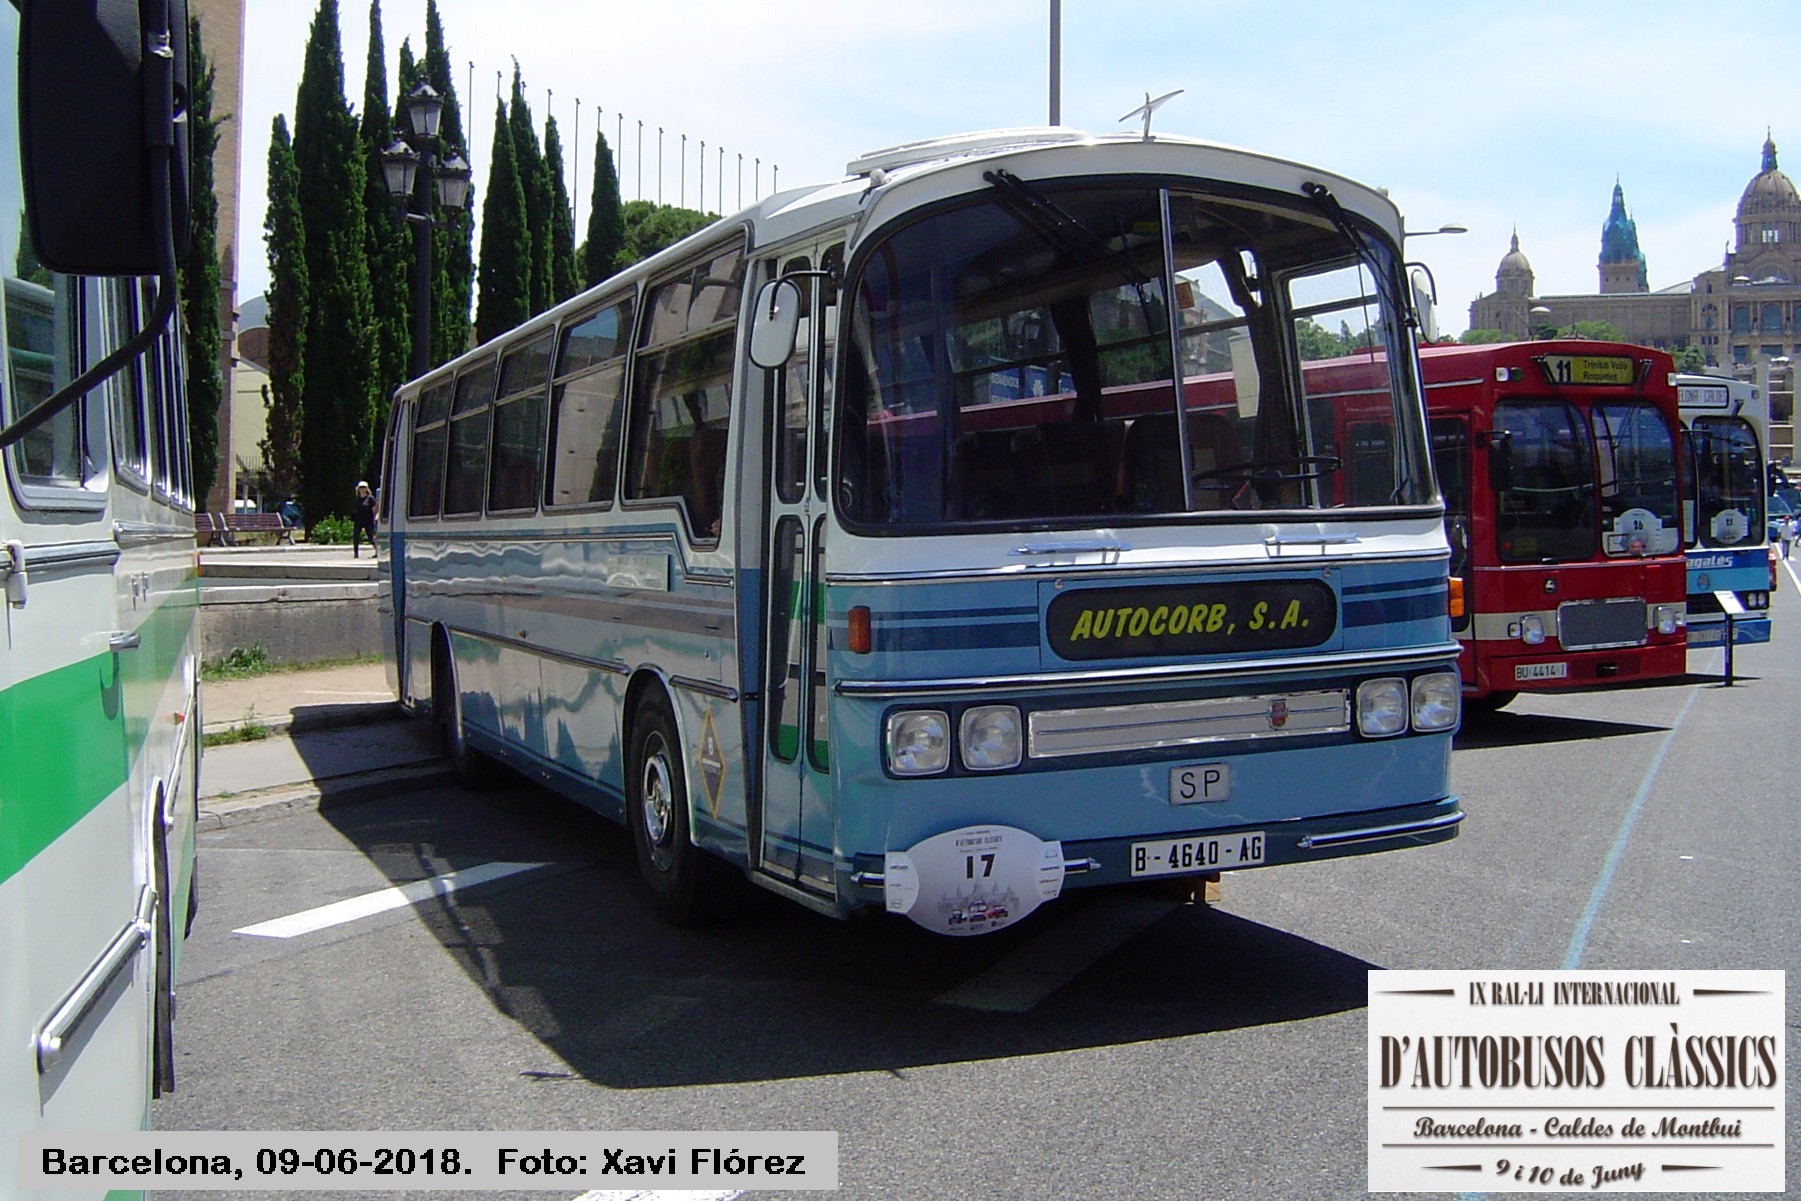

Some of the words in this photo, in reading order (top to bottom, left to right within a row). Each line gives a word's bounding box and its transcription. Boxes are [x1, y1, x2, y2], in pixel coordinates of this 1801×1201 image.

[1556, 360, 1571, 382] 11
[1070, 604, 1235, 641] AUTOCORB,
[1249, 600, 1309, 631] S.A.
[1180, 769, 1220, 799] SP
[966, 853, 995, 879] 17
